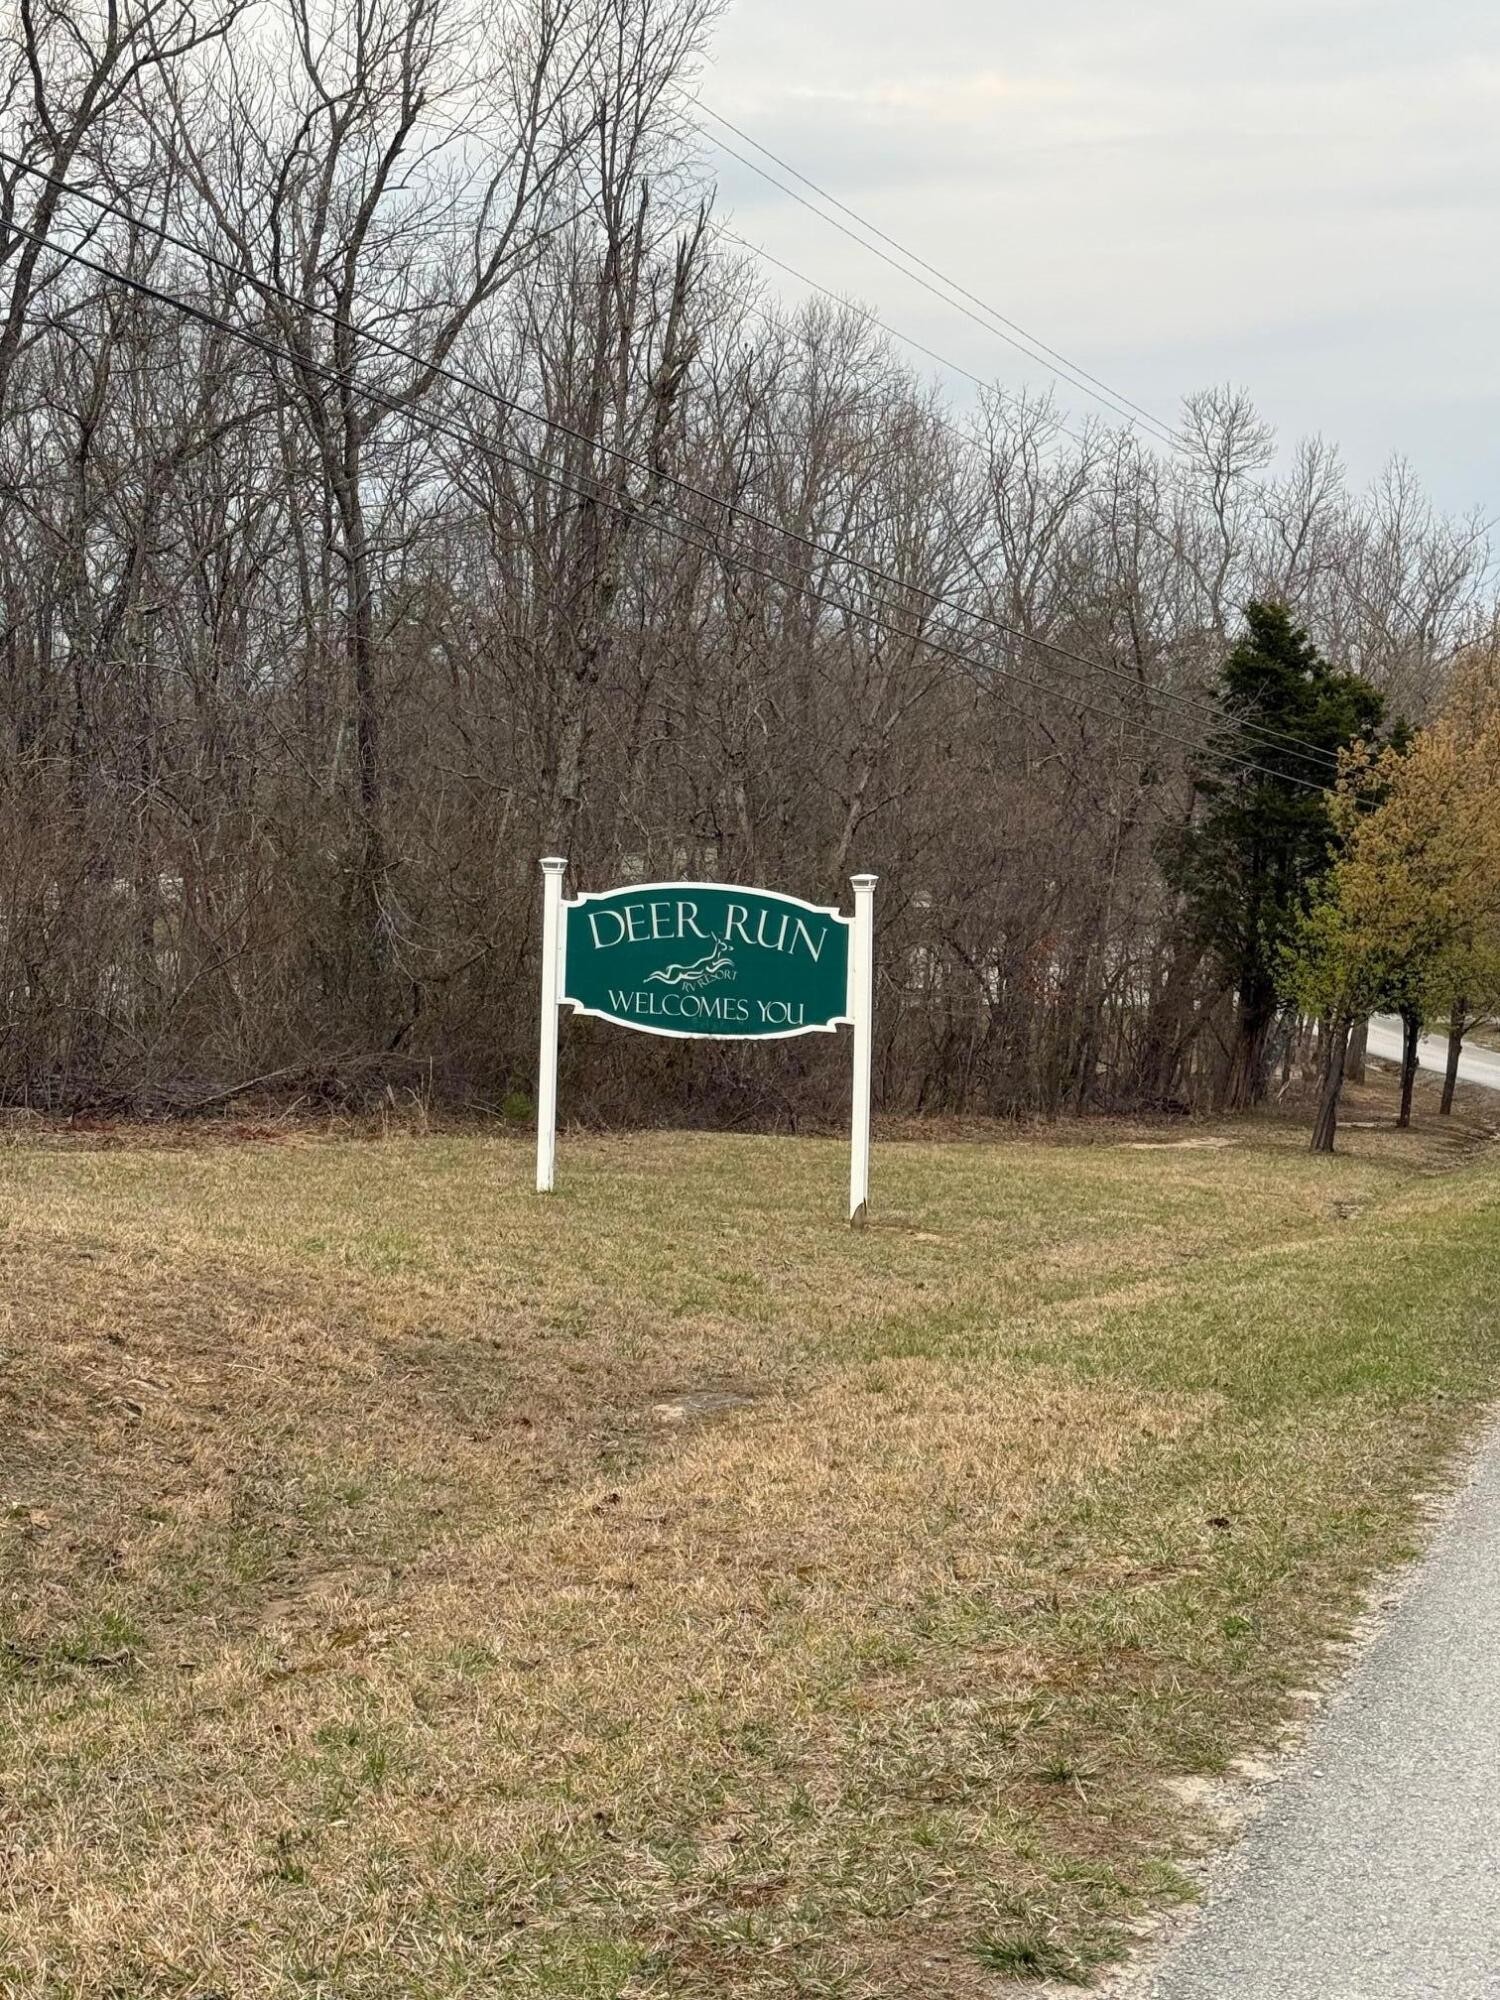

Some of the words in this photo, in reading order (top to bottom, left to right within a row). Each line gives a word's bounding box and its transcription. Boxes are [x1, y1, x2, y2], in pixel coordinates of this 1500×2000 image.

[588, 901, 710, 949] DEER
[725, 904, 827, 963] RUN
[682, 981, 697, 992] RV
[697, 969, 737, 989] RESORT
[608, 989, 749, 1021] WELCOMES
[757, 1000, 804, 1025] YOU
